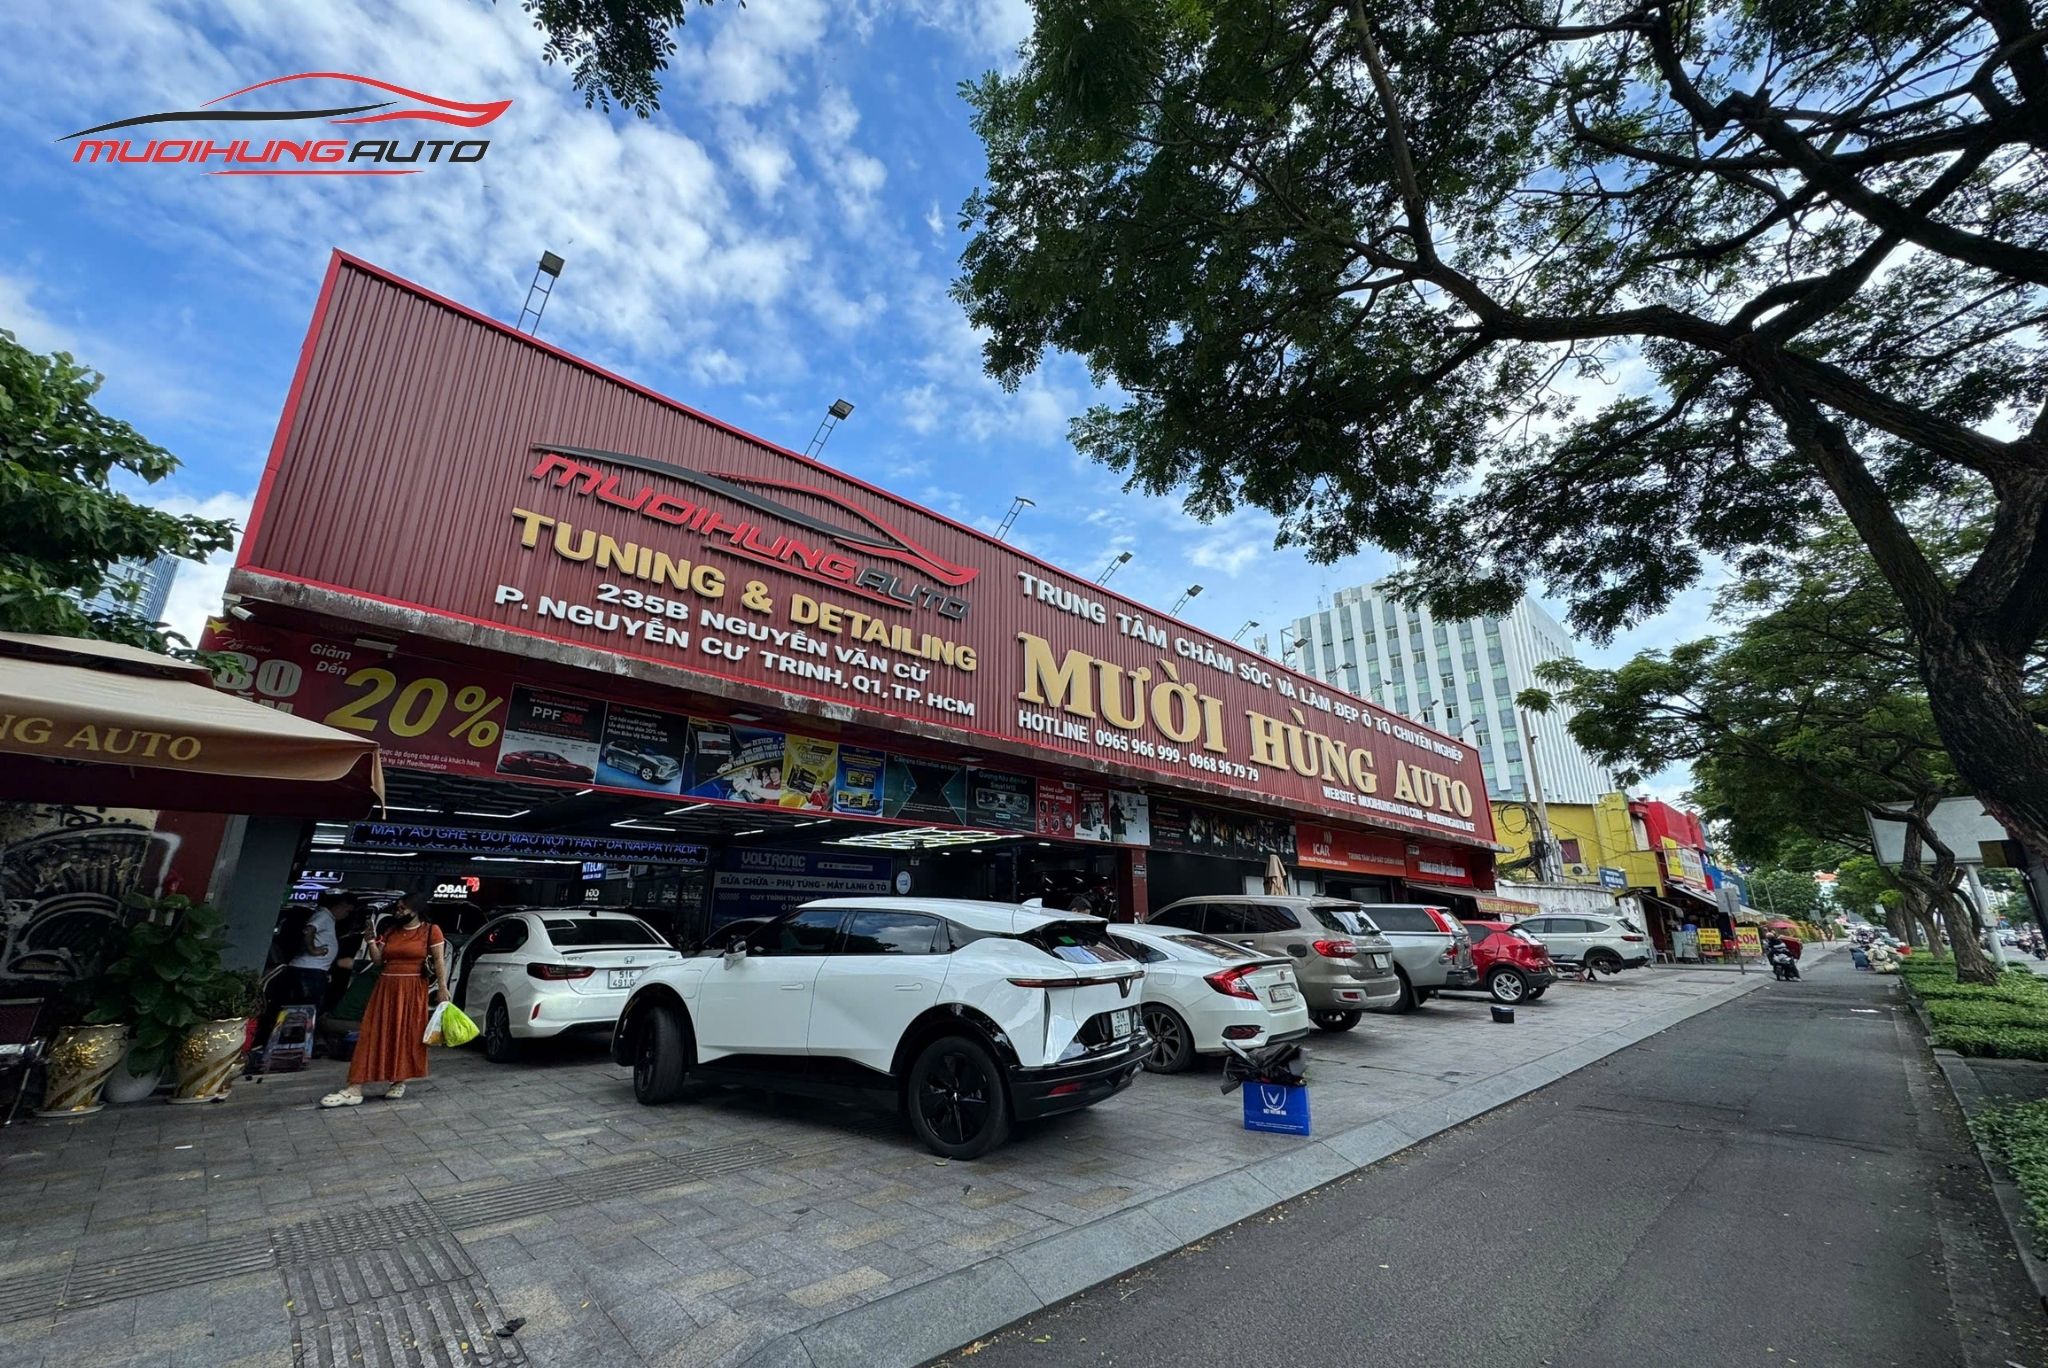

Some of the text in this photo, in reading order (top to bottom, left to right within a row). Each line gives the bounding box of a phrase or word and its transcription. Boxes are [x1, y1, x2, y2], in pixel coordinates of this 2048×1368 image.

[512, 508, 977, 671] TUNING & DETAILING
[310, 642, 351, 661] Giảm
[495, 585, 528, 610] P.
[538, 596, 689, 648] NGUYỄN
[701, 636, 750, 661] CƯ
[597, 583, 930, 682] 235B NGUYỄN VĂN CỪ
[316, 660, 348, 677] Đến
[1018, 571, 1463, 765] TRUNG TÂM CHĂM SÓC VÀ LÀM ĐẸP Ô TÔ CHUYÊN NGHIỆP
[322, 667, 503, 748] 20%
[532, 706, 562, 721] PPF
[1018, 632, 1473, 818] MƯỜI HÙNG AUTO
[64, 724, 201, 761] AUTO
[1095, 729, 1128, 752] 0965
[1131, 738, 1154, 758] 966
[1157, 745, 1180, 763] 999
[1189, 752, 1216, 772] 0968
[1219, 759, 1231, 776] 96
[1231, 763, 1245, 778] 79
[1247, 766, 1259, 781] 79
[741, 851, 806, 867] VOLTRONIC
